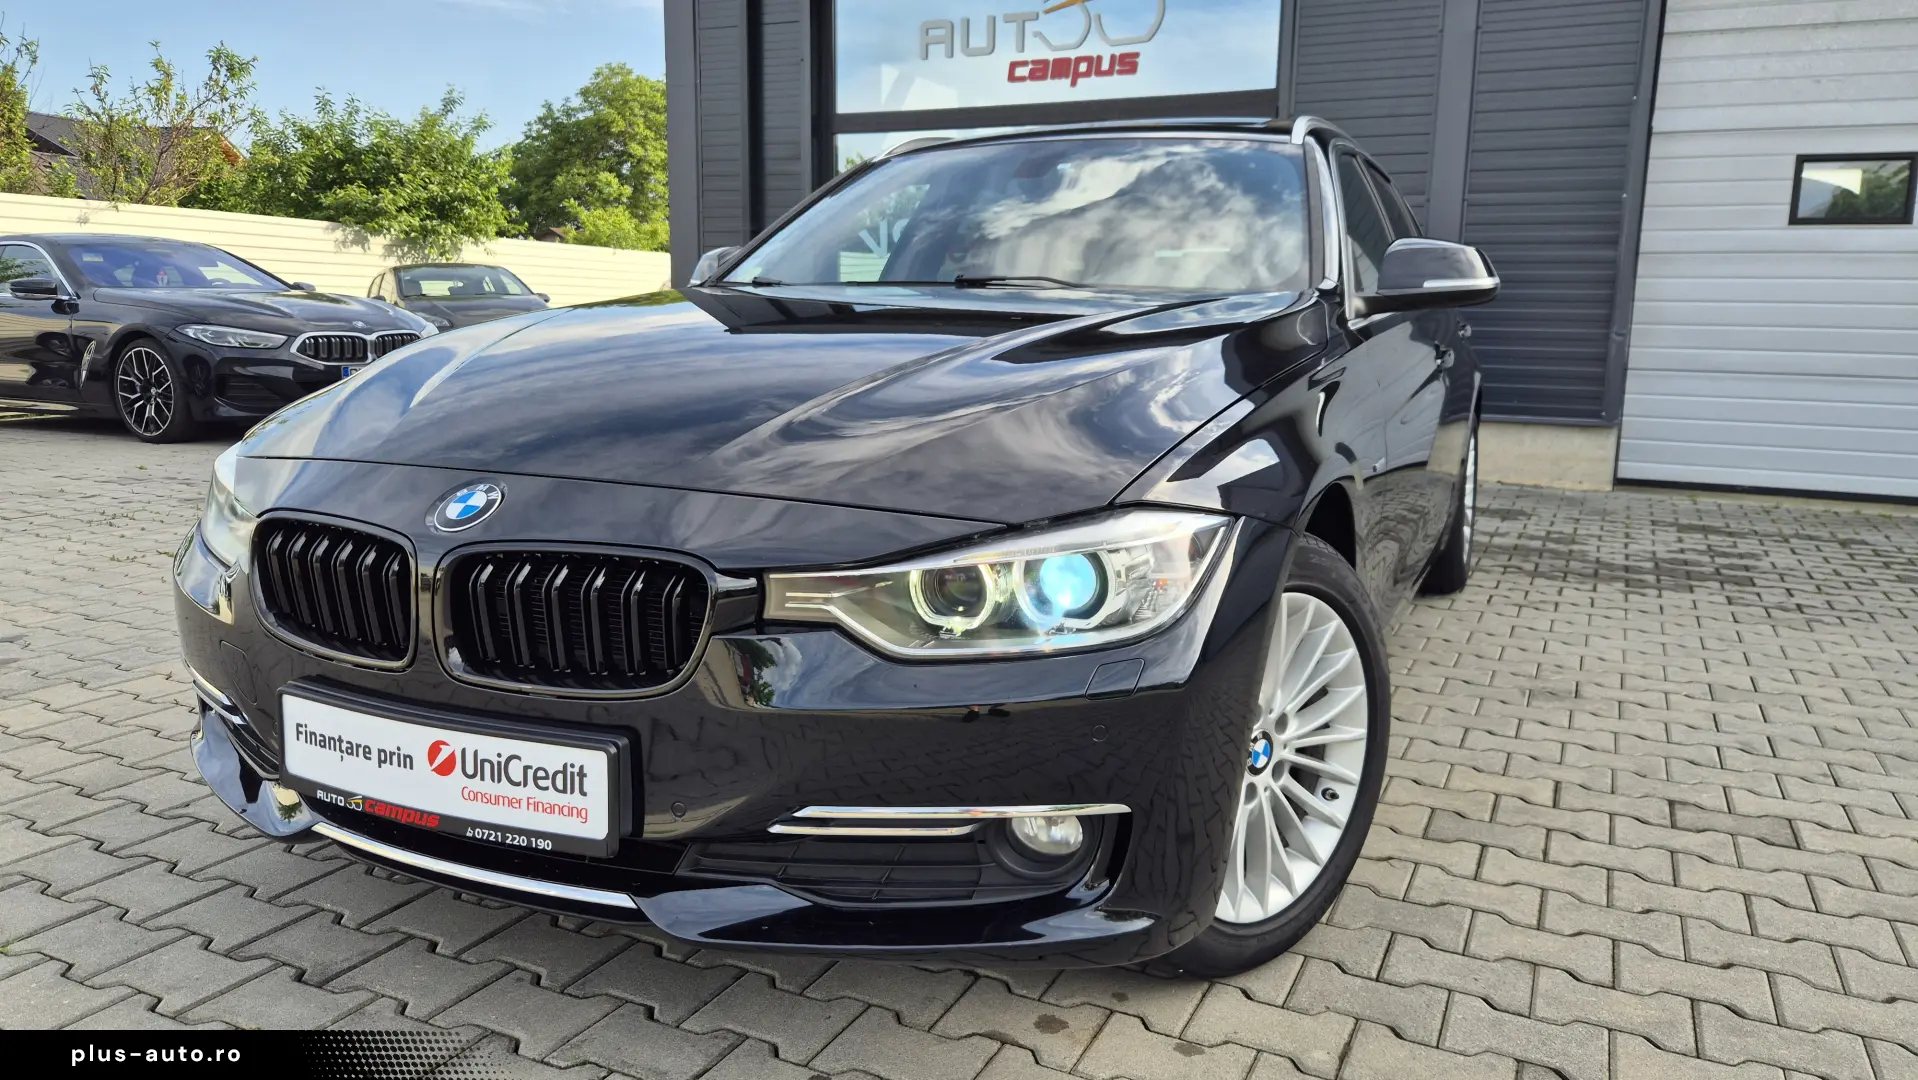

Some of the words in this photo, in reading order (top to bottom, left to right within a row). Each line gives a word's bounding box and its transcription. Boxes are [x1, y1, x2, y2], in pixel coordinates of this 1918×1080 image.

[1007, 52, 1140, 87] campus
[295, 722, 372, 762] Finanțare
[377, 746, 414, 770] prin
[460, 747, 588, 797] UniCredit
[316, 789, 345, 807] AUTO
[364, 799, 440, 828] campus
[461, 786, 523, 809] Consumer
[526, 796, 588, 824] Financing
[474, 828, 502, 843] 0721
[505, 833, 527, 847] 220
[530, 837, 552, 851] 190
